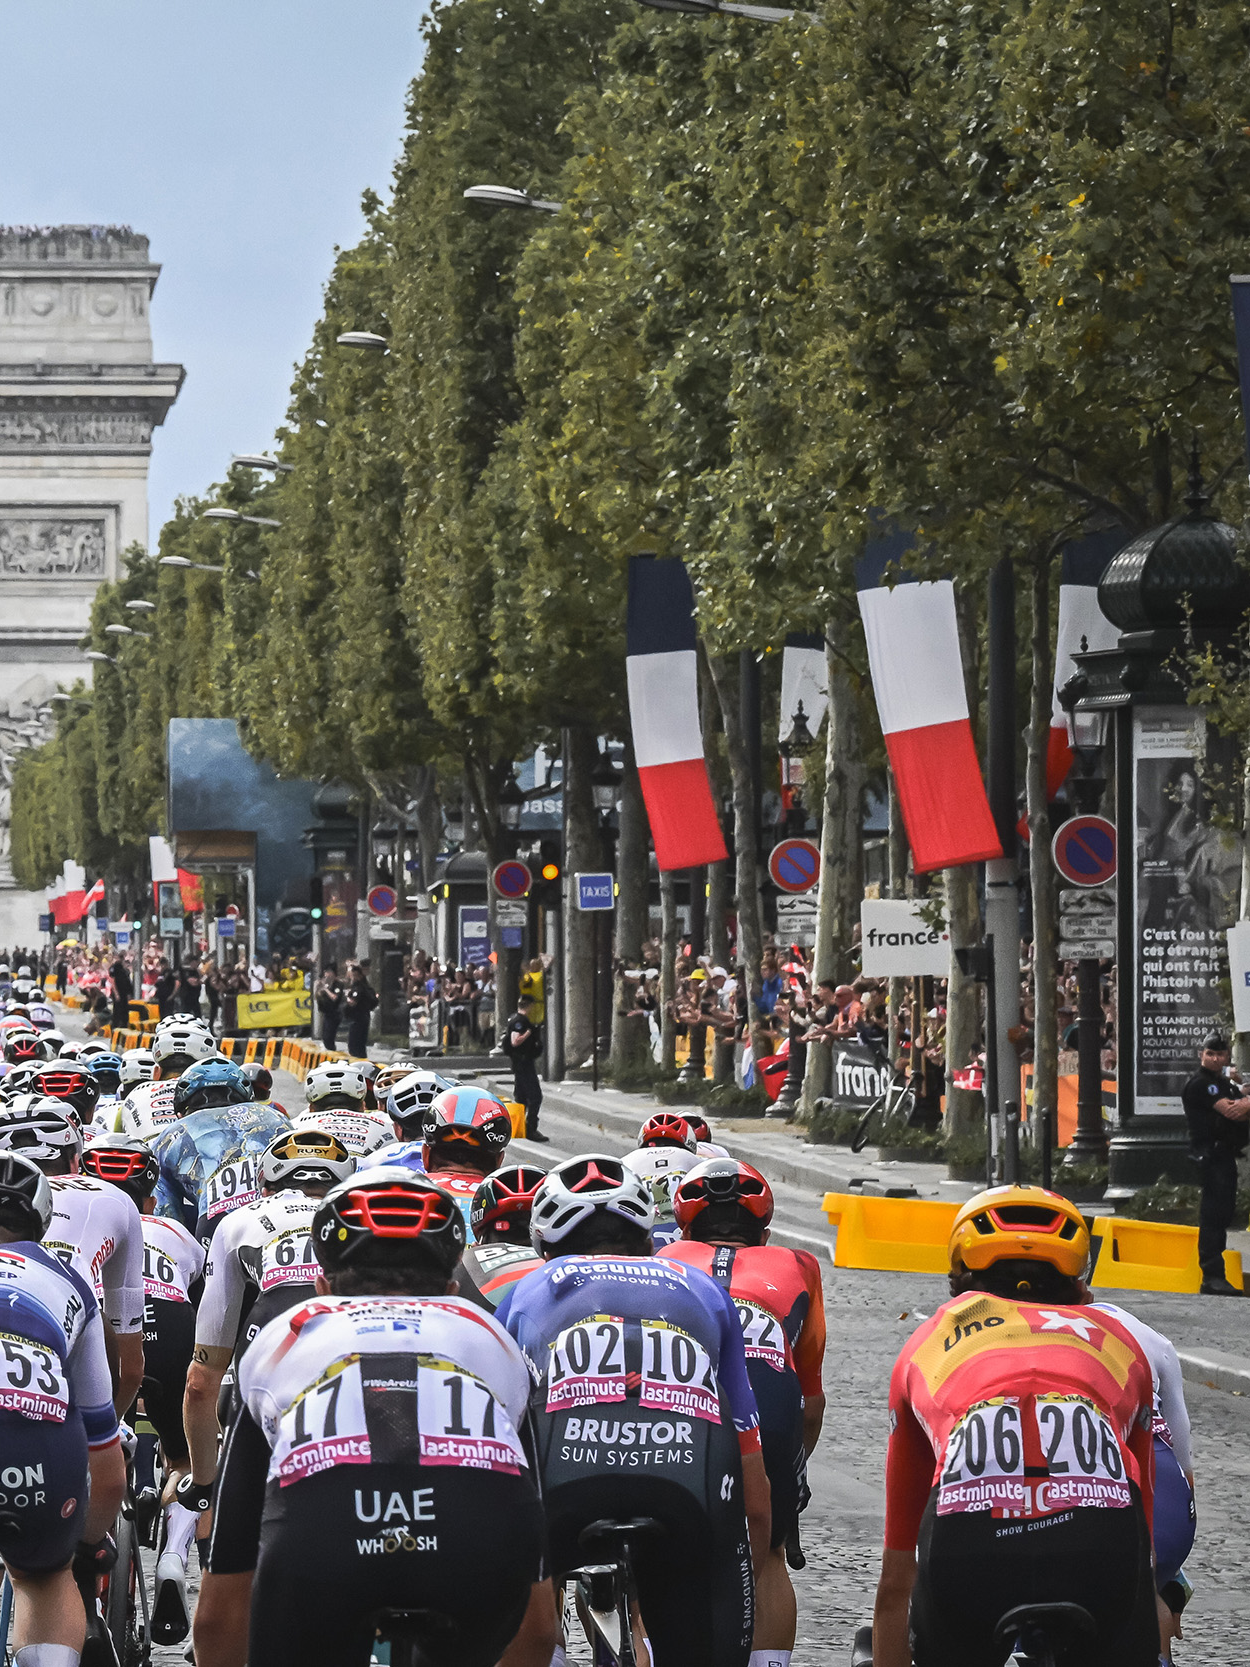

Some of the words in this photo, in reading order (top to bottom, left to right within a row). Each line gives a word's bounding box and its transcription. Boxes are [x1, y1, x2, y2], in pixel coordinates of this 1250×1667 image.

[582, 886, 610, 898] TAXIS
[866, 928, 939, 947] france
[1143, 928, 1177, 940] C'est
[1180, 928, 1205, 940] fou
[1143, 947, 1164, 956] ces
[1143, 960, 1162, 974] qui
[1165, 962, 1190, 972] ont
[1193, 960, 1219, 972] fait
[249, 1001, 271, 1013] LCL
[1142, 990, 1195, 1003] France.
[1142, 1016, 1153, 1024] LA
[1154, 1016, 1195, 1025] GRANDE
[1142, 1027, 1153, 1035] DE
[1142, 1038, 1187, 1046] NOUVEAU
[1142, 1049, 1193, 1058] OUVERTURE
[297, 1147, 330, 1155] RUDY
[209, 1160, 254, 1205] 194
[275, 1232, 313, 1267] 67
[142, 1248, 175, 1284] 16
[589, 1274, 660, 1287] WINDOWS
[740, 1305, 777, 1349] 22
[944, 1315, 1005, 1353] Uno
[552, 1323, 622, 1384] 102
[1, 1339, 60, 1396] 53
[548, 1378, 626, 1405] lastminute
[571, 1395, 597, 1408] .com
[640, 1381, 720, 1416] lastminute
[291, 1375, 343, 1450] 17
[443, 1375, 496, 1439] 17
[564, 1417, 694, 1445] BRUSTOR
[1039, 1404, 1123, 1480] 206
[419, 1435, 522, 1467] lastminute
[560, 1446, 598, 1464] SUN
[606, 1449, 694, 1467] SYSTEMS
[943, 1405, 1020, 1485] 206
[459, 1456, 493, 1470] .com
[354, 1487, 436, 1523] UAE
[938, 1479, 1025, 1507] lastminute
[996, 1524, 1023, 1538] SHOW
[1027, 1512, 1075, 1532] COURAGE!
[355, 1535, 438, 1555] WHOOSH
[740, 1558, 752, 1629] WINDOWS
